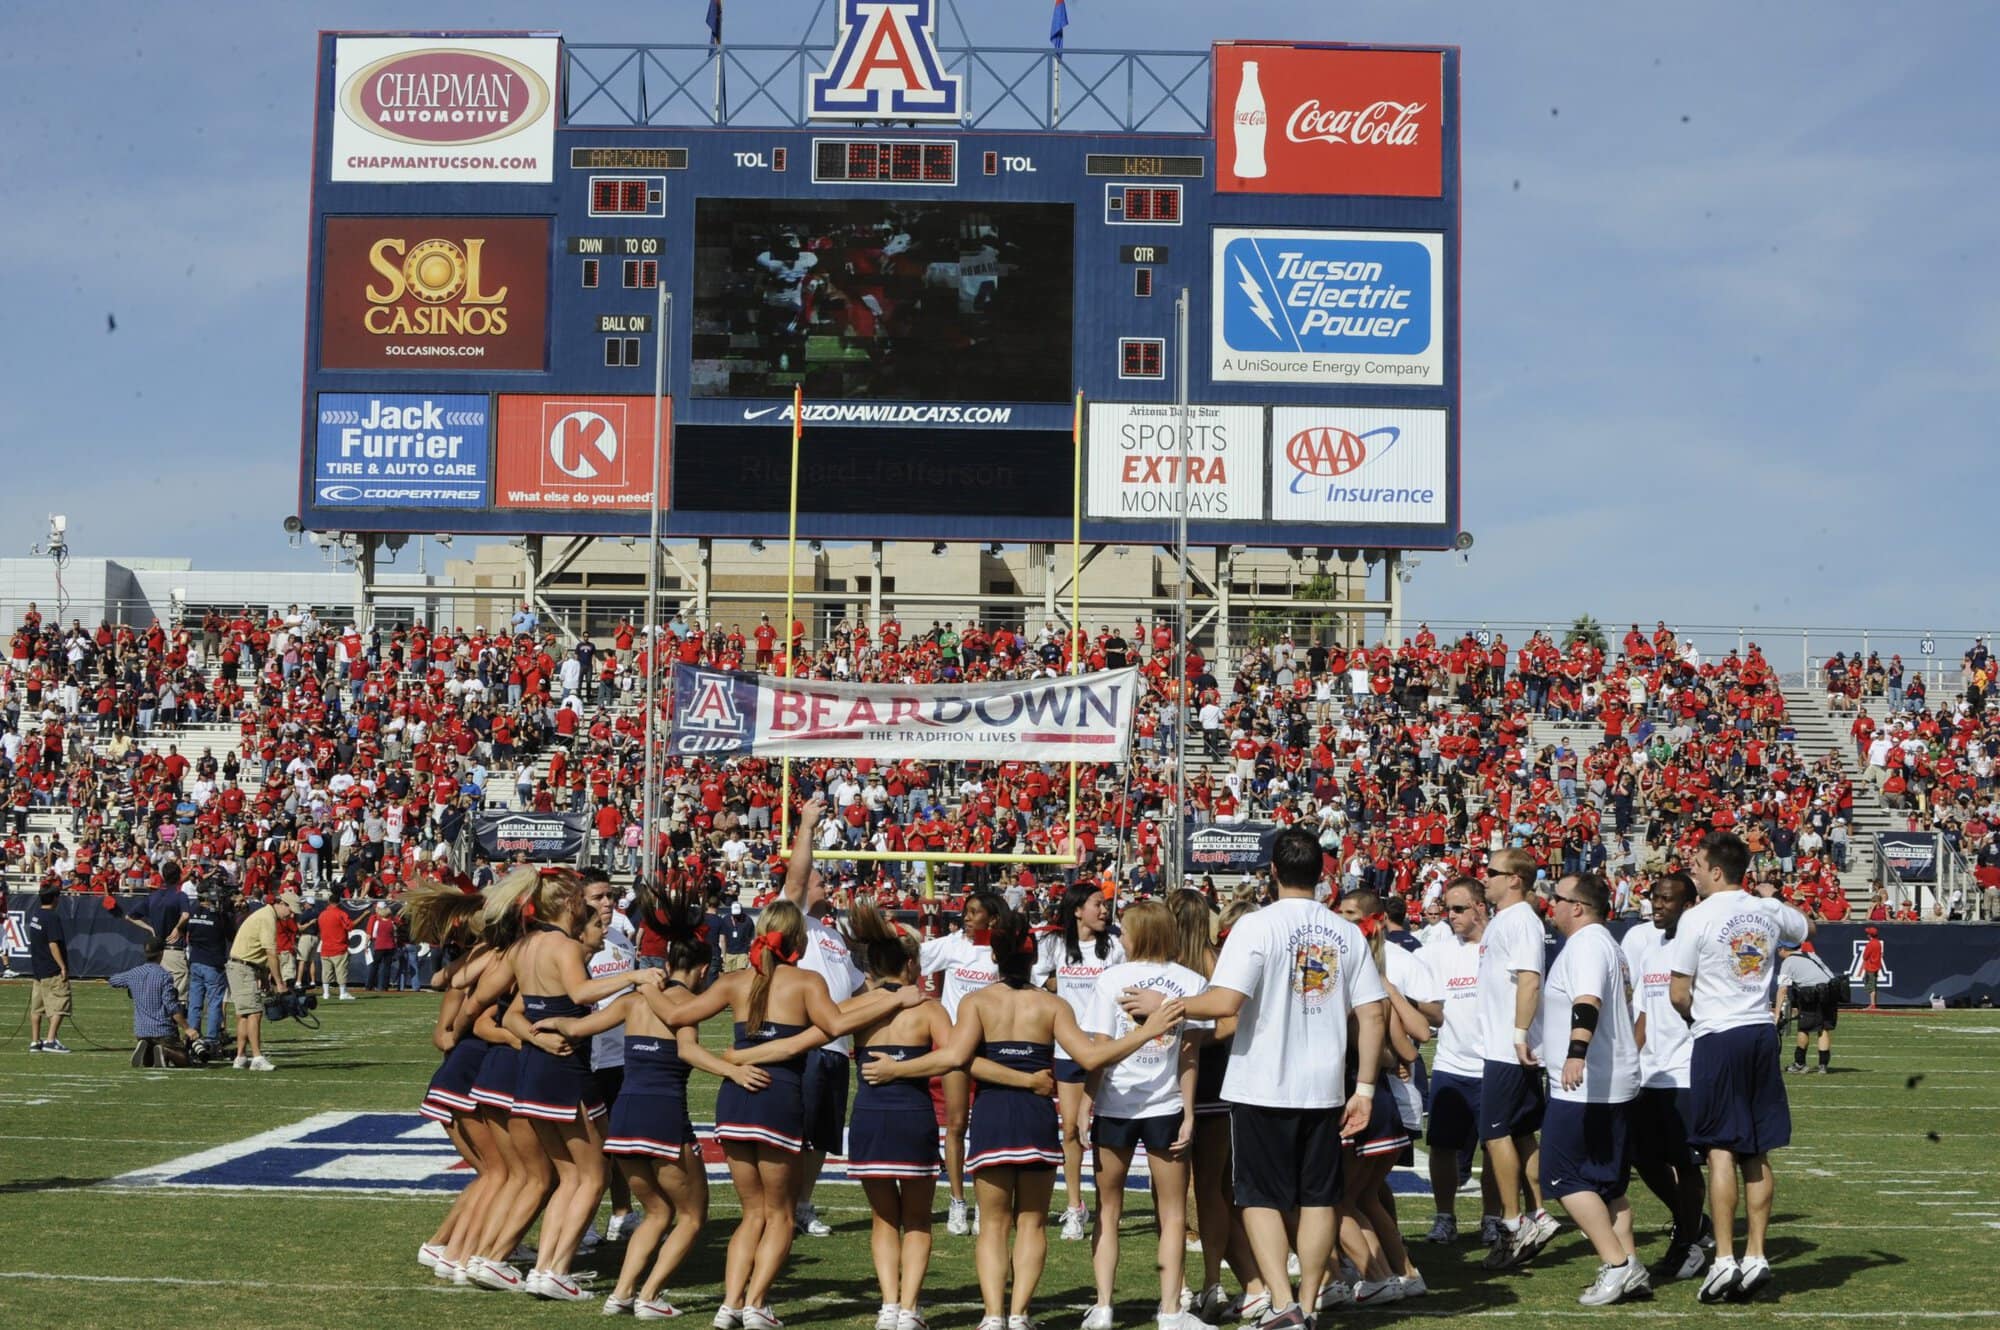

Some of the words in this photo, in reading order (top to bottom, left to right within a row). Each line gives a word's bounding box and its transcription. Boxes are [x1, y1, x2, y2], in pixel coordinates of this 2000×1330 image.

[376, 73, 512, 108] CHAPMAN
[379, 110, 509, 123] AUTOMOTIVE
[1286, 99, 1427, 145] Coca-Cola
[347, 156, 537, 170] CHAPMANTUCSON.COM
[734, 152, 768, 167] TOL
[1002, 157, 1036, 172] TOL
[579, 238, 602, 253] DWN
[625, 239, 638, 253] TO
[641, 239, 657, 253] GO
[1134, 247, 1154, 262] QTR
[1276, 252, 1382, 282] Tucson
[1286, 281, 1412, 309] Electric
[364, 306, 507, 335] CASINOS
[602, 316, 626, 331] BALL
[629, 316, 645, 331] ON
[1299, 309, 1411, 337] Power
[385, 346, 484, 357] SOLCASINOS.COM
[1223, 359, 1233, 371] A
[1237, 359, 1309, 372] UniSource
[1312, 360, 1361, 376] Energy
[1365, 361, 1431, 378] Company
[361, 400, 444, 430] Jack
[778, 405, 1011, 424] ARIZONAWILDCATS.COM
[1128, 406, 1168, 416] Arizona
[1199, 407, 1220, 417] Star
[341, 429, 463, 459] Furrier
[1120, 424, 1227, 451] SPORTS
[1294, 427, 1358, 476] AAA
[326, 463, 363, 475] TIRE
[367, 463, 379, 475] &
[385, 463, 429, 476] AUTO
[433, 464, 477, 476] CARE
[1121, 455, 1227, 484] EXTRA
[508, 491, 541, 502] What
[544, 491, 570, 502] else
[573, 492, 589, 503] do
[592, 493, 614, 505] you
[1326, 483, 1434, 504] Insurance
[1122, 490, 1229, 513] MONDAYS
[1477, 631, 1489, 645] 29
[1922, 640, 1934, 653] 30
[868, 731, 893, 742] THE
[900, 731, 976, 743] TRADITION
[979, 732, 1016, 743] LIVES
[1286, 924, 1349, 954] HOMECOMING
[592, 959, 630, 974] ARIZONA
[1058, 967, 1104, 977] ARIZONA
[1136, 1056, 1160, 1064] 2009
